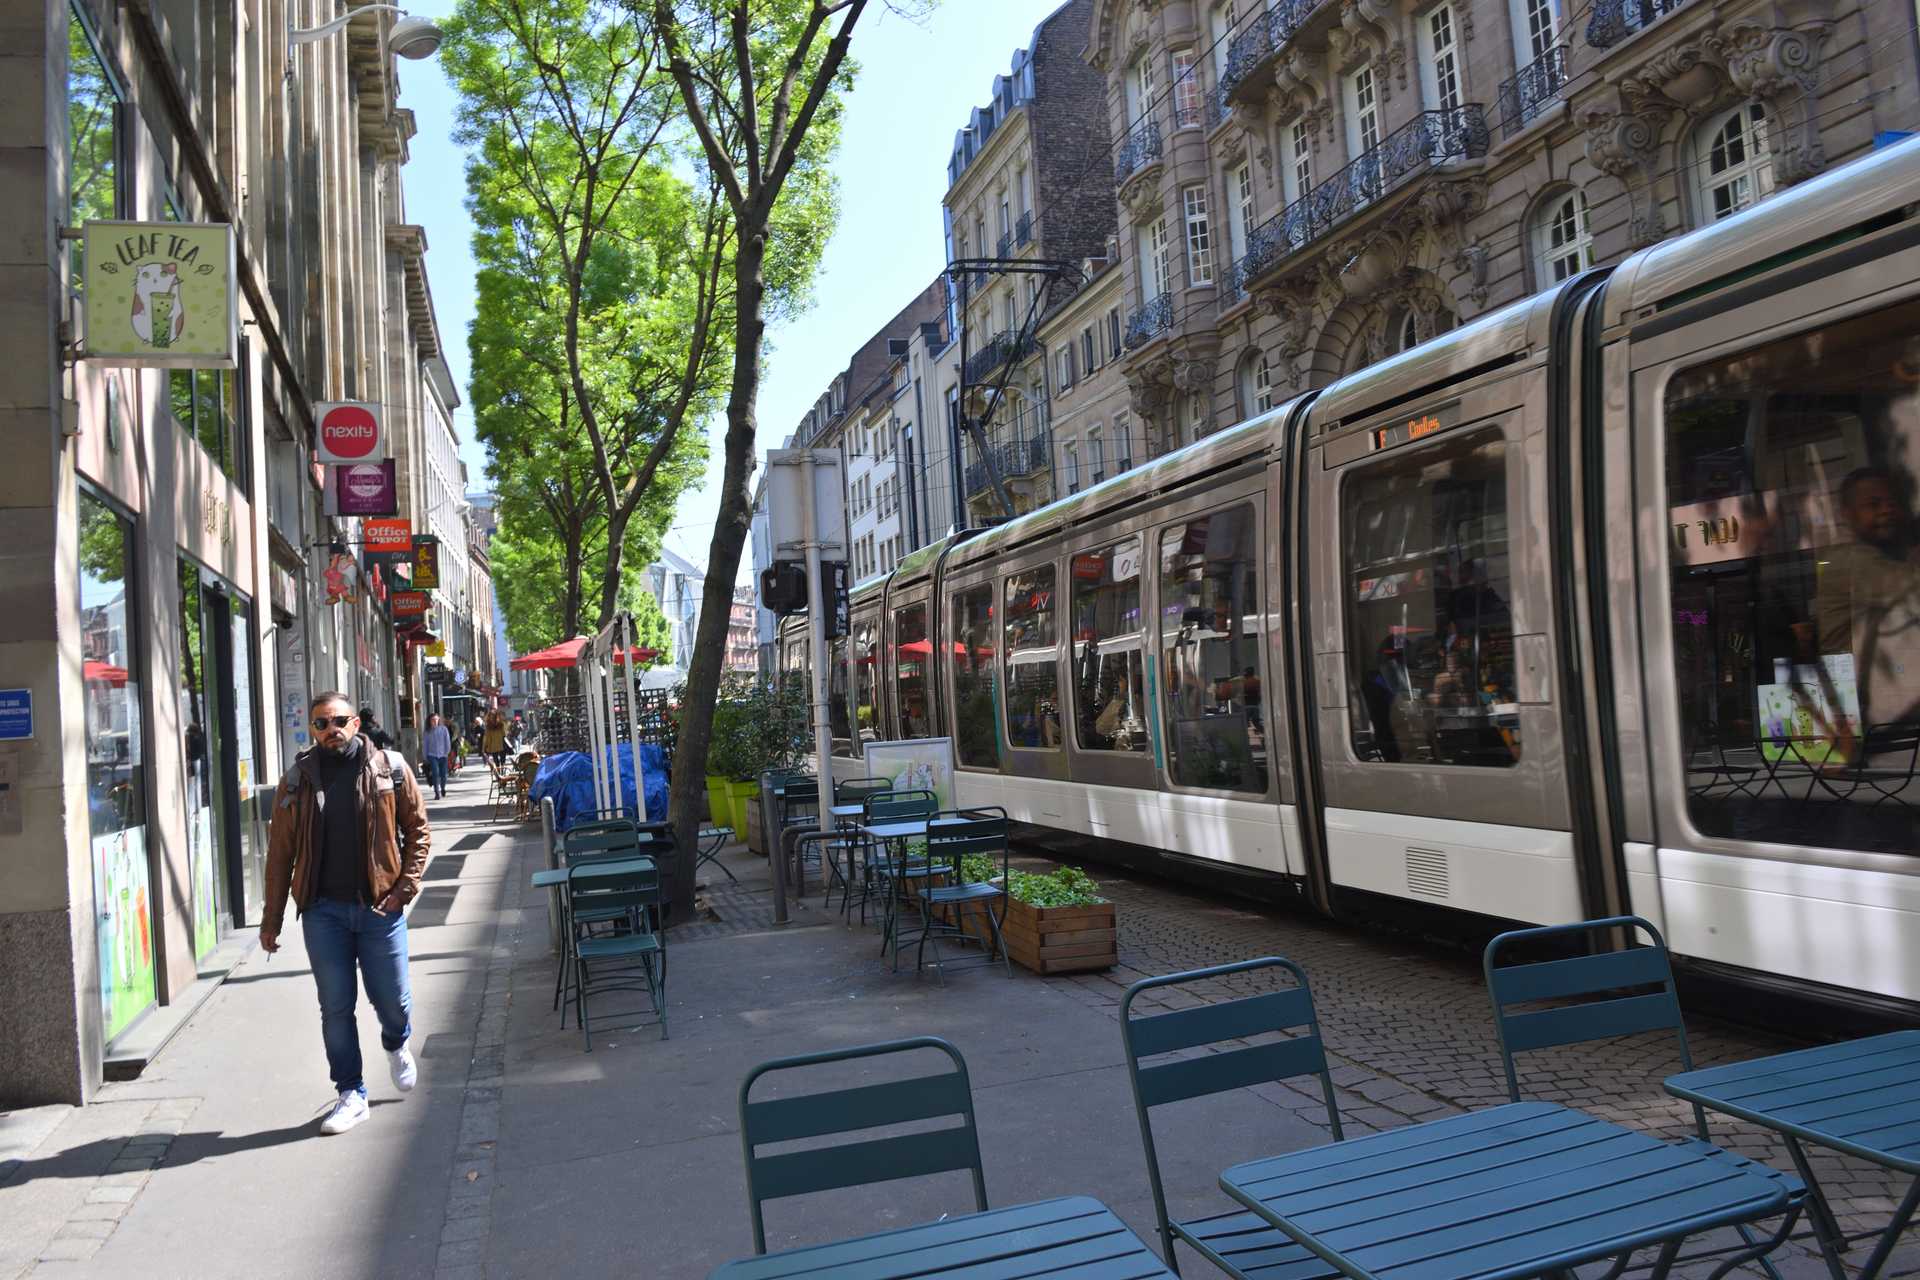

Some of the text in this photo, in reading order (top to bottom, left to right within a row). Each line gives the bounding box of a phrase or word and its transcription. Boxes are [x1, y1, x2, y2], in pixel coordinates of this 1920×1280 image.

[115, 232, 199, 266] LEAF TEA
[325, 425, 373, 438] nexity
[367, 526, 408, 537] Office
